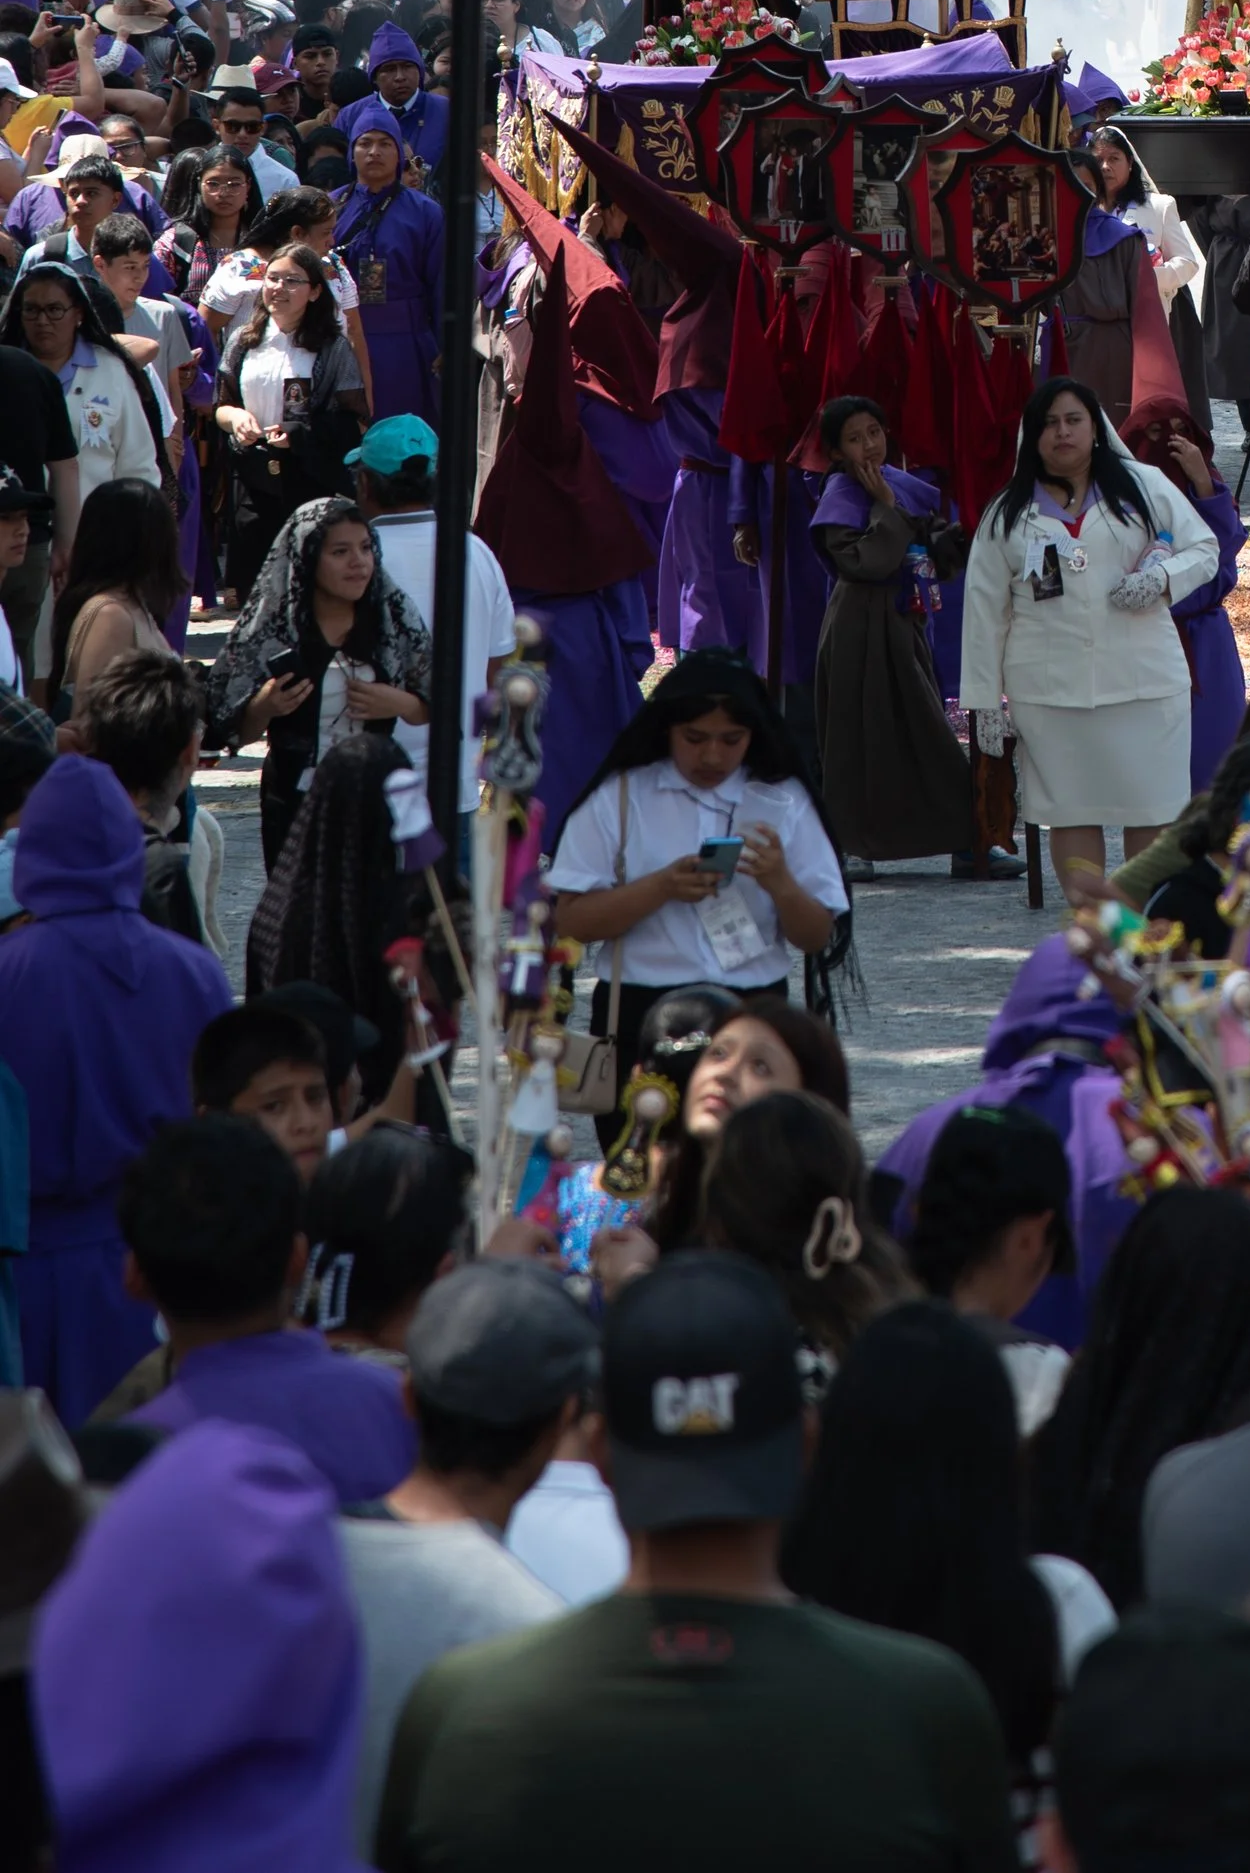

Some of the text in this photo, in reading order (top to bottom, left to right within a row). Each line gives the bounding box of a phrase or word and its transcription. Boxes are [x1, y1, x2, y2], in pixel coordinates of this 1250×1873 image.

[779, 219, 804, 245] IV
[881, 227, 907, 252] III
[1011, 277, 1021, 303] I
[651, 1372, 740, 1434] CAT
